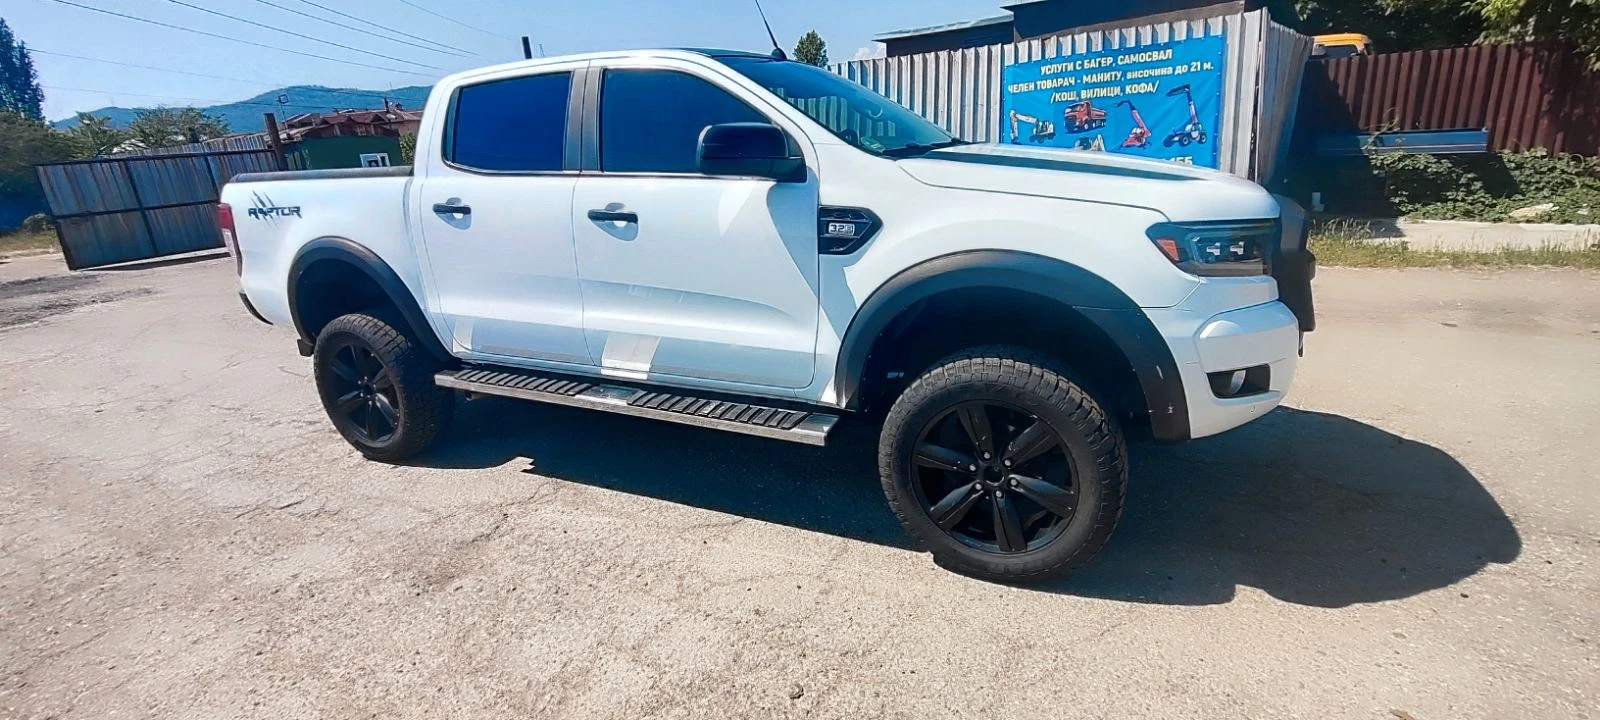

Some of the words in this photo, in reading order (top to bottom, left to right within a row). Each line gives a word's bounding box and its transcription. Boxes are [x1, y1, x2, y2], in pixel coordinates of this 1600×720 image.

[1040, 63, 1074, 76] УСЛУГИ
[1075, 60, 1082, 70] С
[1083, 56, 1116, 69] БАГЕР,
[1117, 48, 1173, 65] САМОСВАЛ
[1007, 82, 1035, 94] ЧЕЛЕН
[1036, 76, 1076, 90] ТОВАРАЧ
[1082, 70, 1125, 85] МАНИТУ,
[1126, 66, 1173, 80] височина
[1174, 64, 1188, 76] до
[1190, 61, 1201, 72] 21
[1203, 61, 1214, 71] м.
[1050, 91, 1079, 104] /КОШ,
[1080, 84, 1124, 99] ВИЛИЦИ,
[1125, 80, 1160, 95] КОФА/
[247, 205, 302, 220] RAPTOR
